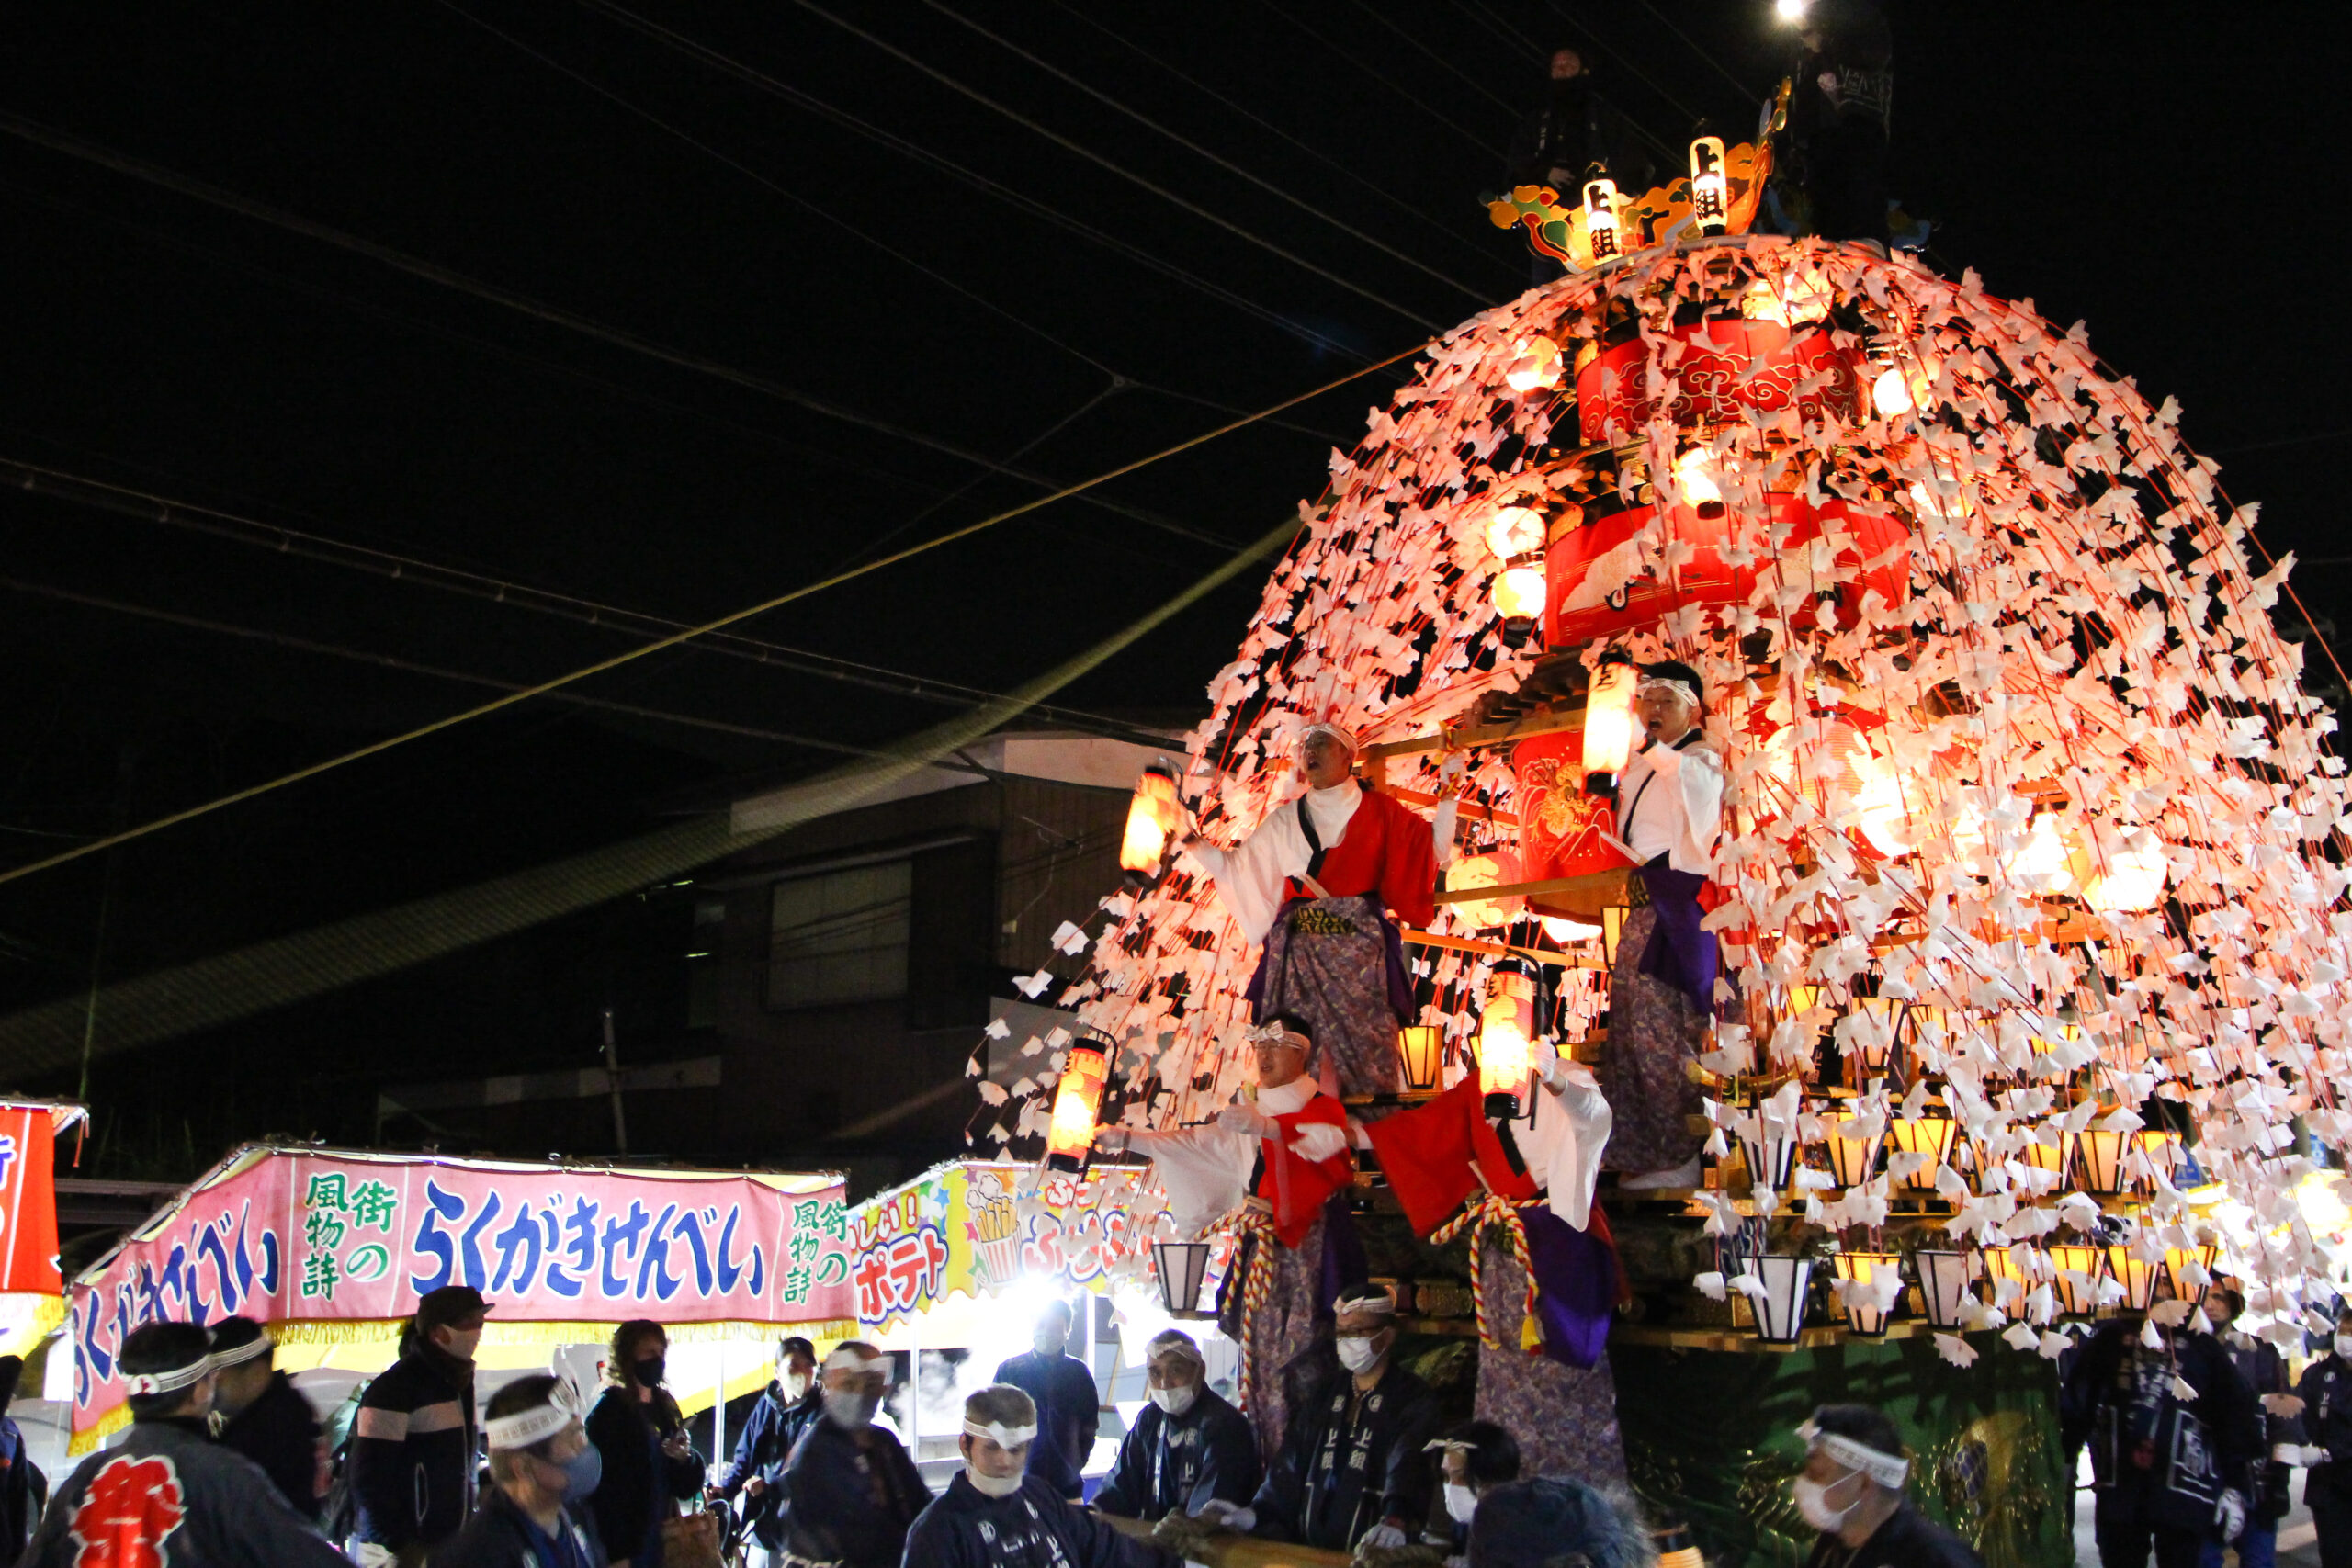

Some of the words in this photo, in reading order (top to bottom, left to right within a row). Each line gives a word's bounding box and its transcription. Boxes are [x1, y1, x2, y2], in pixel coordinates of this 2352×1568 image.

[1587, 184, 1619, 260] 上組
[1694, 142, 1724, 220] 上組
[301, 1171, 350, 1302] 風物詩
[345, 1179, 399, 1283] 街の
[410, 1176, 766, 1301] らくがきせんべい
[783, 1199, 820, 1306] 風物詩
[818, 1199, 849, 1288] 街の
[855, 1230, 947, 1321] ポテト
[1349, 1427, 1374, 1472] 上組
[69, 1454, 184, 1568] 祭
